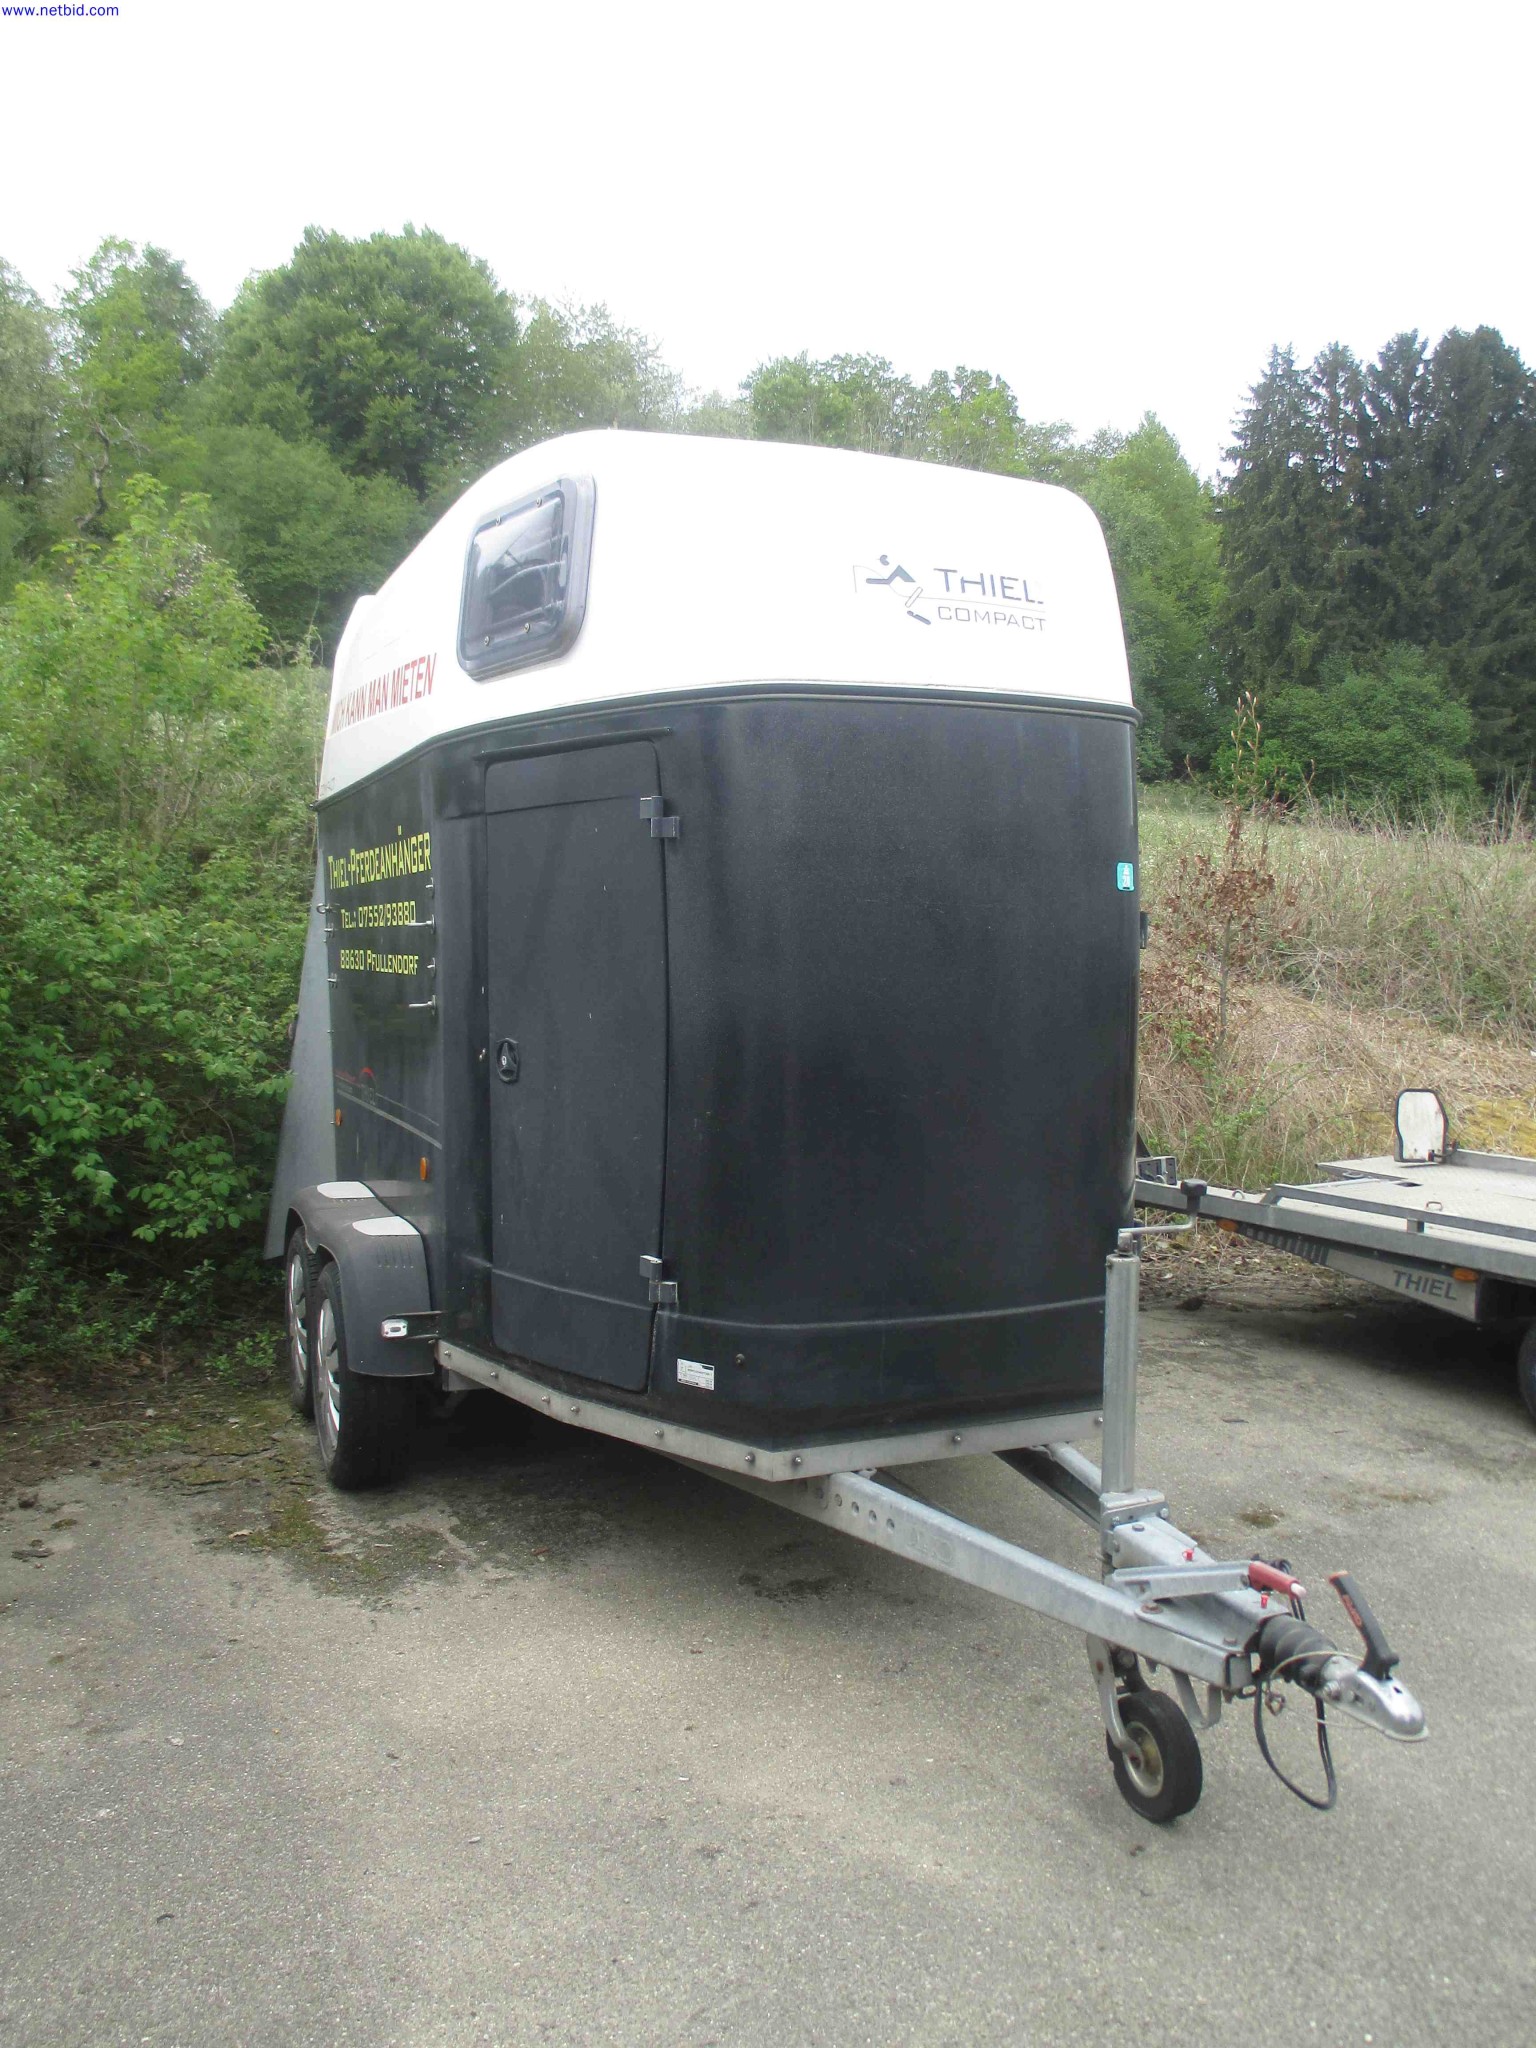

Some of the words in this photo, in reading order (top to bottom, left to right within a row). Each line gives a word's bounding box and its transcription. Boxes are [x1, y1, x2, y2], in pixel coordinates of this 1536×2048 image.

[933, 567, 1044, 605] THIEL
[937, 606, 1047, 632] COMPACT
[367, 672, 389, 717] MAN
[390, 652, 437, 709] MIETEN
[358, 900, 416, 928] 07552/93880
[340, 949, 365, 971] 88630
[366, 949, 419, 975] PFULLENDORF
[1393, 1269, 1457, 1301] THIEL
